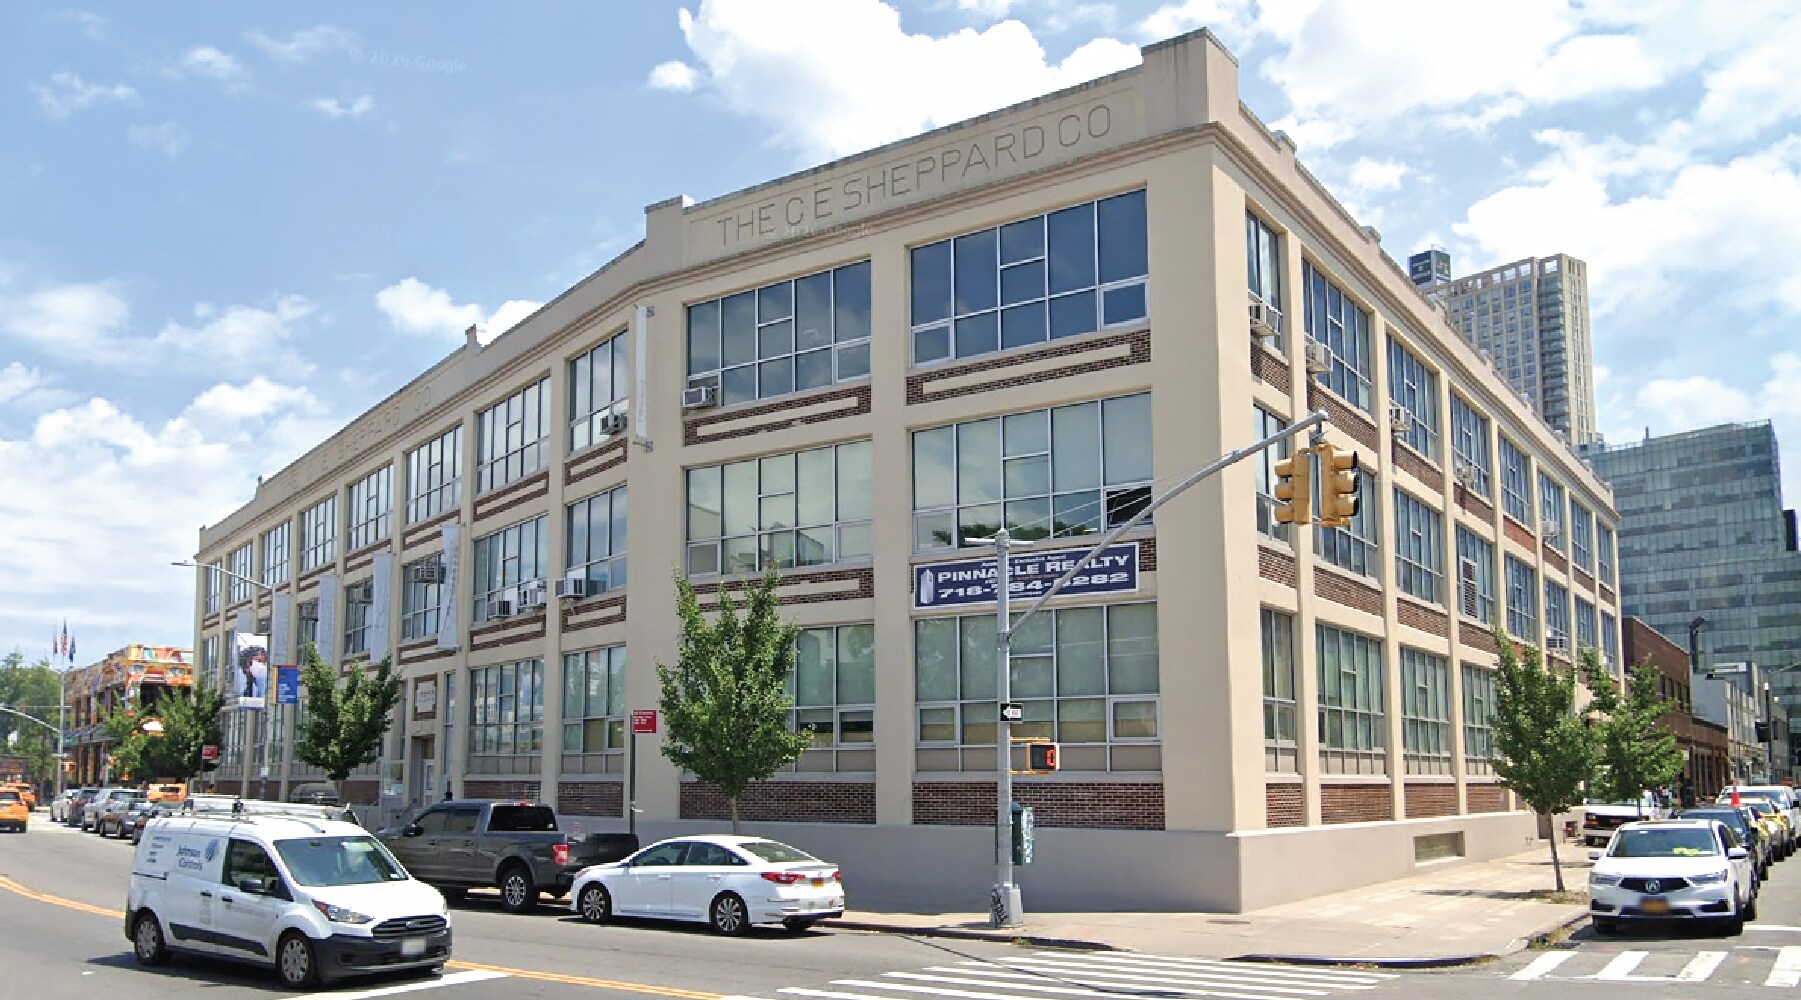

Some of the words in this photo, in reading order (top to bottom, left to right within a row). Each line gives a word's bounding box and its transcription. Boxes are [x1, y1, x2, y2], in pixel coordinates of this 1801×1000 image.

[717, 203, 775, 246] THE
[814, 187, 833, 219] E
[843, 125, 1045, 211] SHEPPARD
[1058, 104, 1112, 148] CO
[1044, 554, 1130, 573] RELTY
